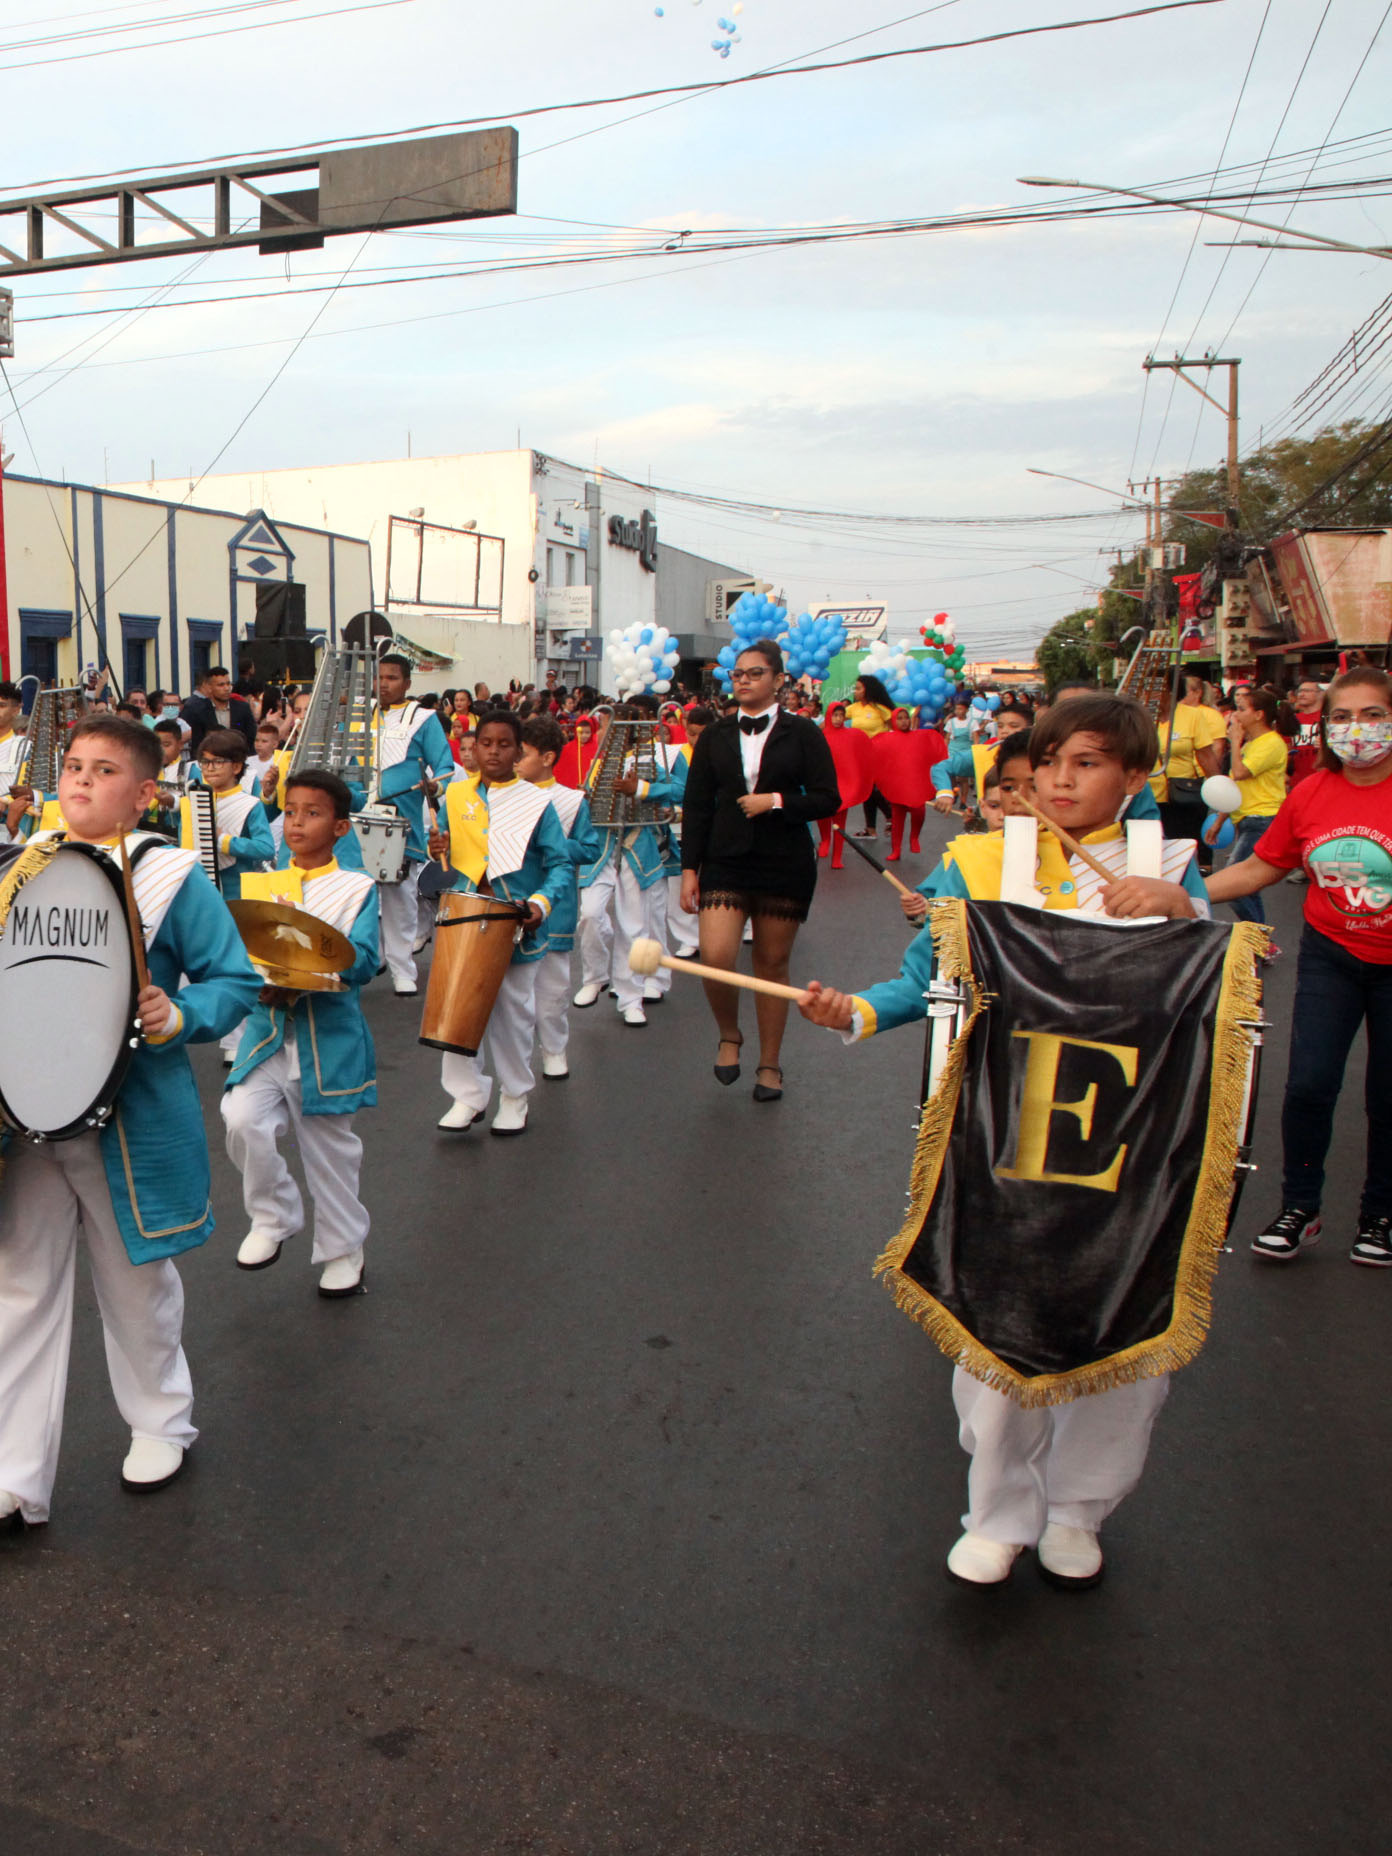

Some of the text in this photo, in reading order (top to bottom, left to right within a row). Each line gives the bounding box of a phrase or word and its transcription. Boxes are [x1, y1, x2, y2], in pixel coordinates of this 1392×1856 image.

[715, 584, 723, 620] STUDIO
[1331, 826, 1356, 837] CIDADE
[1356, 825, 1372, 836] TEM
[1343, 885, 1392, 909] VG
[12, 905, 109, 947] MAGNUM
[994, 1029, 1140, 1193] E
